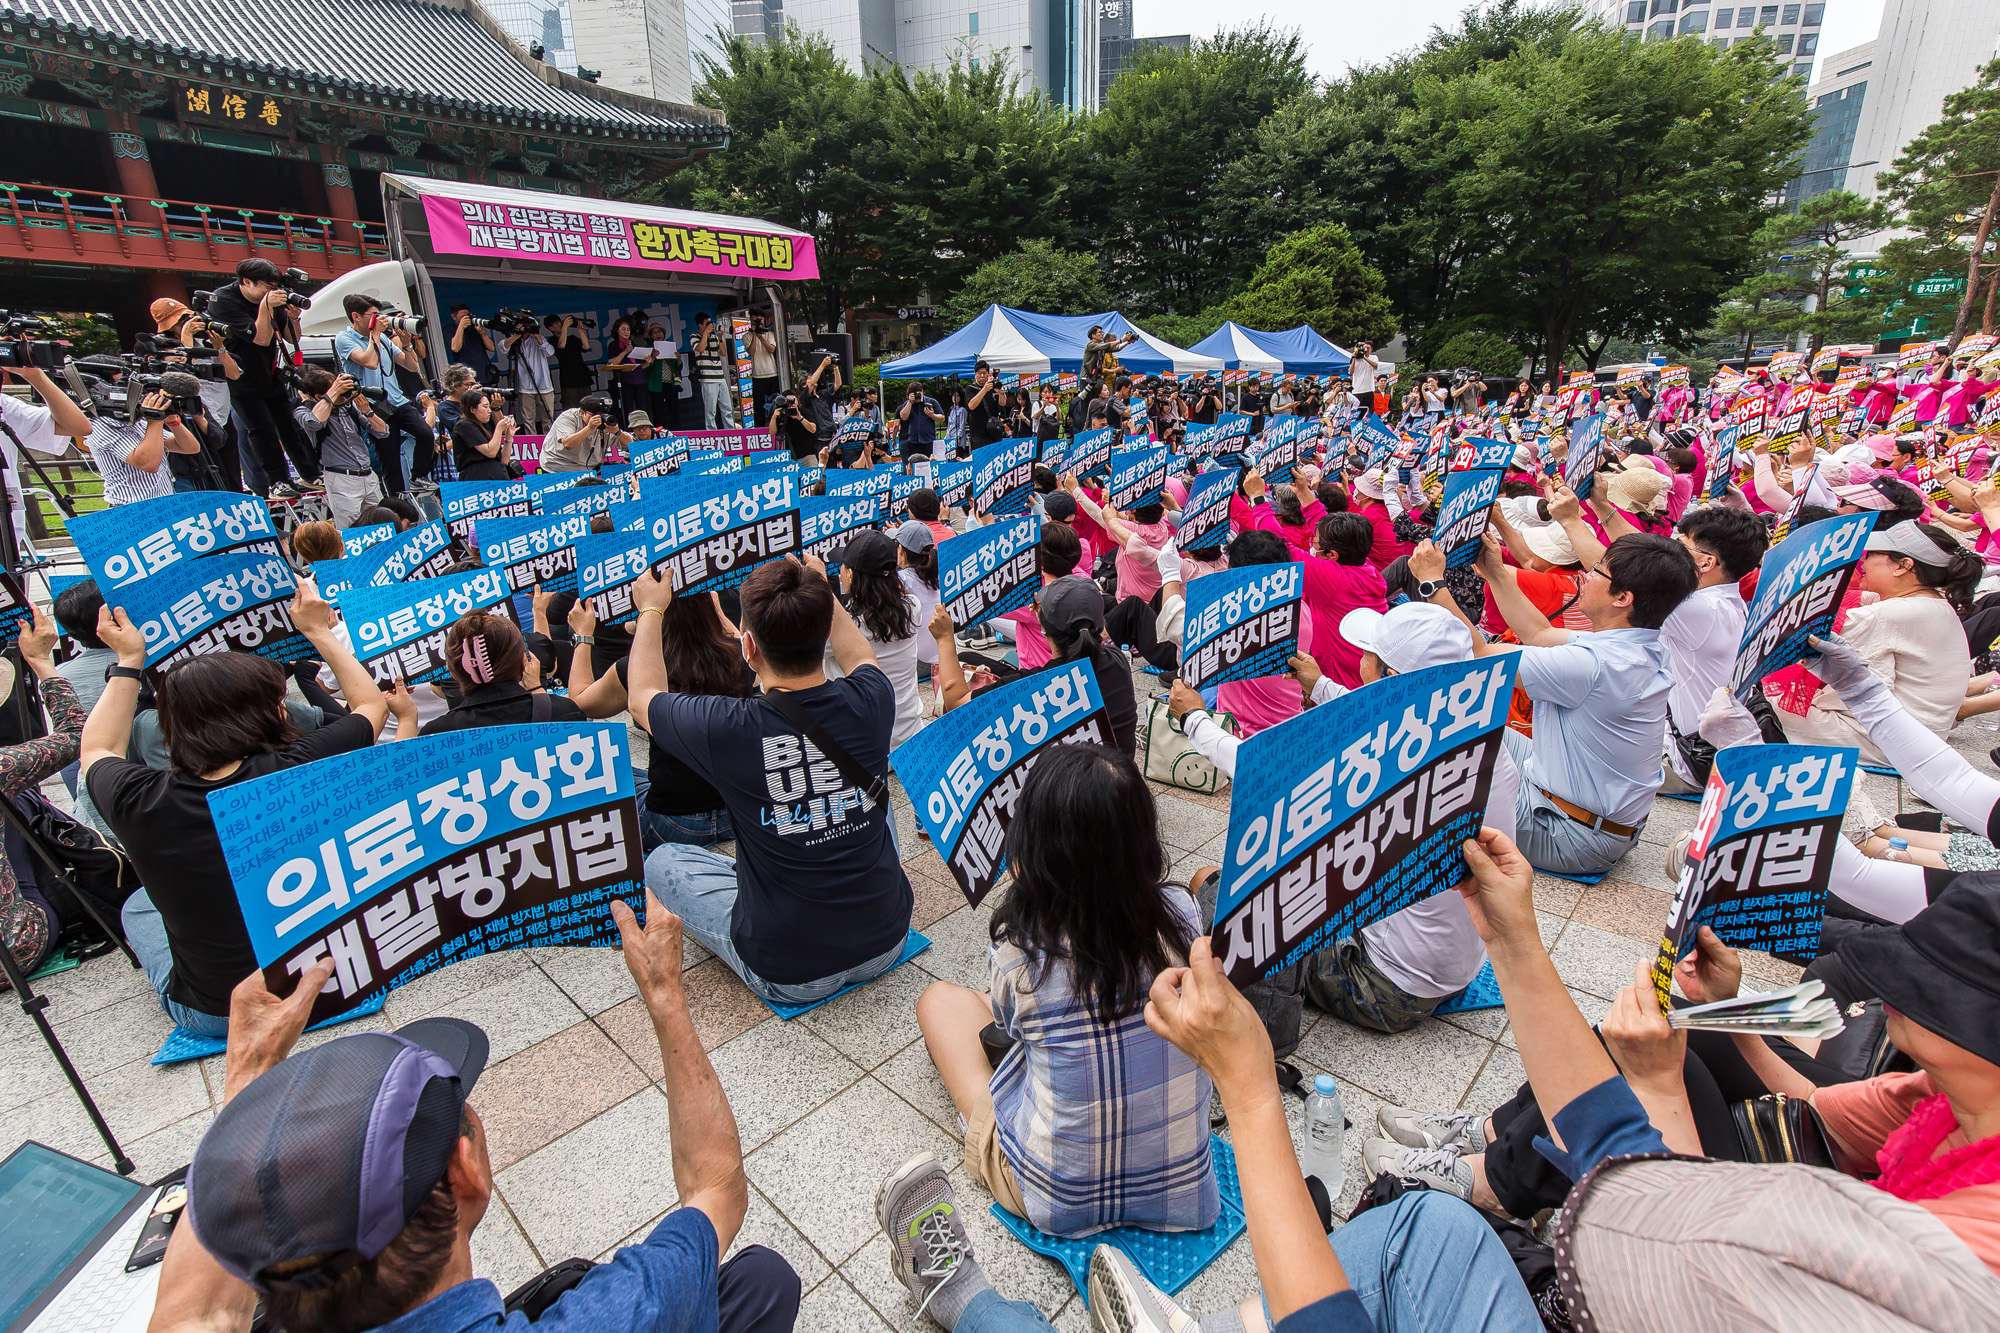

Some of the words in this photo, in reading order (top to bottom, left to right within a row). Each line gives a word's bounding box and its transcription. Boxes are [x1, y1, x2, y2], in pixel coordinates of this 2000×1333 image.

[459, 202, 504, 225] 의사
[507, 207, 585, 233] 집단휴진
[588, 214, 626, 237] 철회
[466, 225, 586, 257] 재발방지법
[589, 234, 631, 260] 제정
[632, 221, 795, 271] 환자촉구대회
[633, 439, 687, 468] 의료정상화
[745, 434, 772, 449] 제정
[975, 440, 1034, 491] 의료정상화
[1112, 446, 1168, 491] 의료정상화
[448, 483, 528, 518] 의료정상화
[652, 475, 793, 553] 의료정상화
[976, 462, 1032, 514] 재발방지법
[1112, 466, 1165, 510] 재발방지법
[1181, 470, 1238, 522] 의료정상화
[1436, 474, 1498, 537] 의료정상화
[104, 500, 270, 589] 의료정상화
[487, 516, 587, 567] 의료정상화
[802, 498, 877, 543] 료정상화
[1176, 496, 1232, 549] 재발방지법
[1440, 507, 1489, 553] 발방지법
[583, 545, 648, 592] 의료정
[657, 515, 794, 592] 재발방지법
[944, 517, 1037, 598] 의료정상화
[1741, 517, 1868, 643] 의료정상화
[140, 559, 297, 656] 의료정상화
[359, 570, 503, 652] 의료정상화
[946, 548, 1036, 626] 재발방지법
[1185, 566, 1299, 652] 의료정상화
[1184, 604, 1294, 688] 재발방지법
[266, 790, 296, 817] 의사
[299, 761, 357, 799] 집단휴진
[359, 745, 389, 768] 철회
[928, 666, 1089, 843] 의료정상화
[1230, 661, 1506, 897] 의료정상화
[225, 817, 287, 861] 촉구대회
[301, 798, 329, 819] 의사
[333, 764, 389, 801] 집단휴진
[391, 749, 420, 772] 철회
[422, 743, 436, 758] 및
[439, 731, 466, 752] 재발
[230, 790, 262, 814] 의사
[231, 820, 319, 883] 환자촉구대회
[333, 797, 361, 822] 의사
[365, 772, 419, 805] 집단휴진
[422, 757, 449, 779] 철회
[453, 750, 466, 767] 및
[468, 741, 494, 758] 재발
[496, 729, 534, 750] 방지법
[267, 729, 619, 938] 의료정상화
[805, 829, 850, 847] ORIGINALITY
[852, 820, 870, 832] JEANS
[1223, 742, 1486, 977] 재발방지법
[1356, 887, 1374, 907] 재발
[1375, 869, 1400, 893] 방지법
[1401, 850, 1418, 870] 제정
[1420, 811, 1471, 856] 환자촉구대회
[1356, 901, 1382, 926] 방지법
[1383, 881, 1400, 904] 제정
[1455, 825, 1476, 844] 의사
[1440, 856, 1456, 873] 의사
[286, 809, 627, 999] 재발방지법
[487, 927, 523, 950] 방지법
[525, 920, 548, 936] 제정
[549, 901, 613, 931] 환자촉구대회
[624, 896, 643, 910] 의사
[1714, 910, 1782, 929] 환자촉구대회
[1793, 905, 1818, 919] 의사
[1717, 899, 1742, 913] 제정
[1742, 890, 1811, 911] 환자촉구대회
[388, 951, 440, 991] 집단휴진
[441, 934, 465, 958] 철회
[469, 926, 482, 940] 및
[484, 914, 510, 936] 재발
[511, 901, 546, 926] 방지법
[547, 898, 569, 915] 제정
[570, 880, 635, 911] 환자촉구대회
[1768, 923, 1792, 937] 의사
[1774, 937, 1820, 954] 집단휴진
